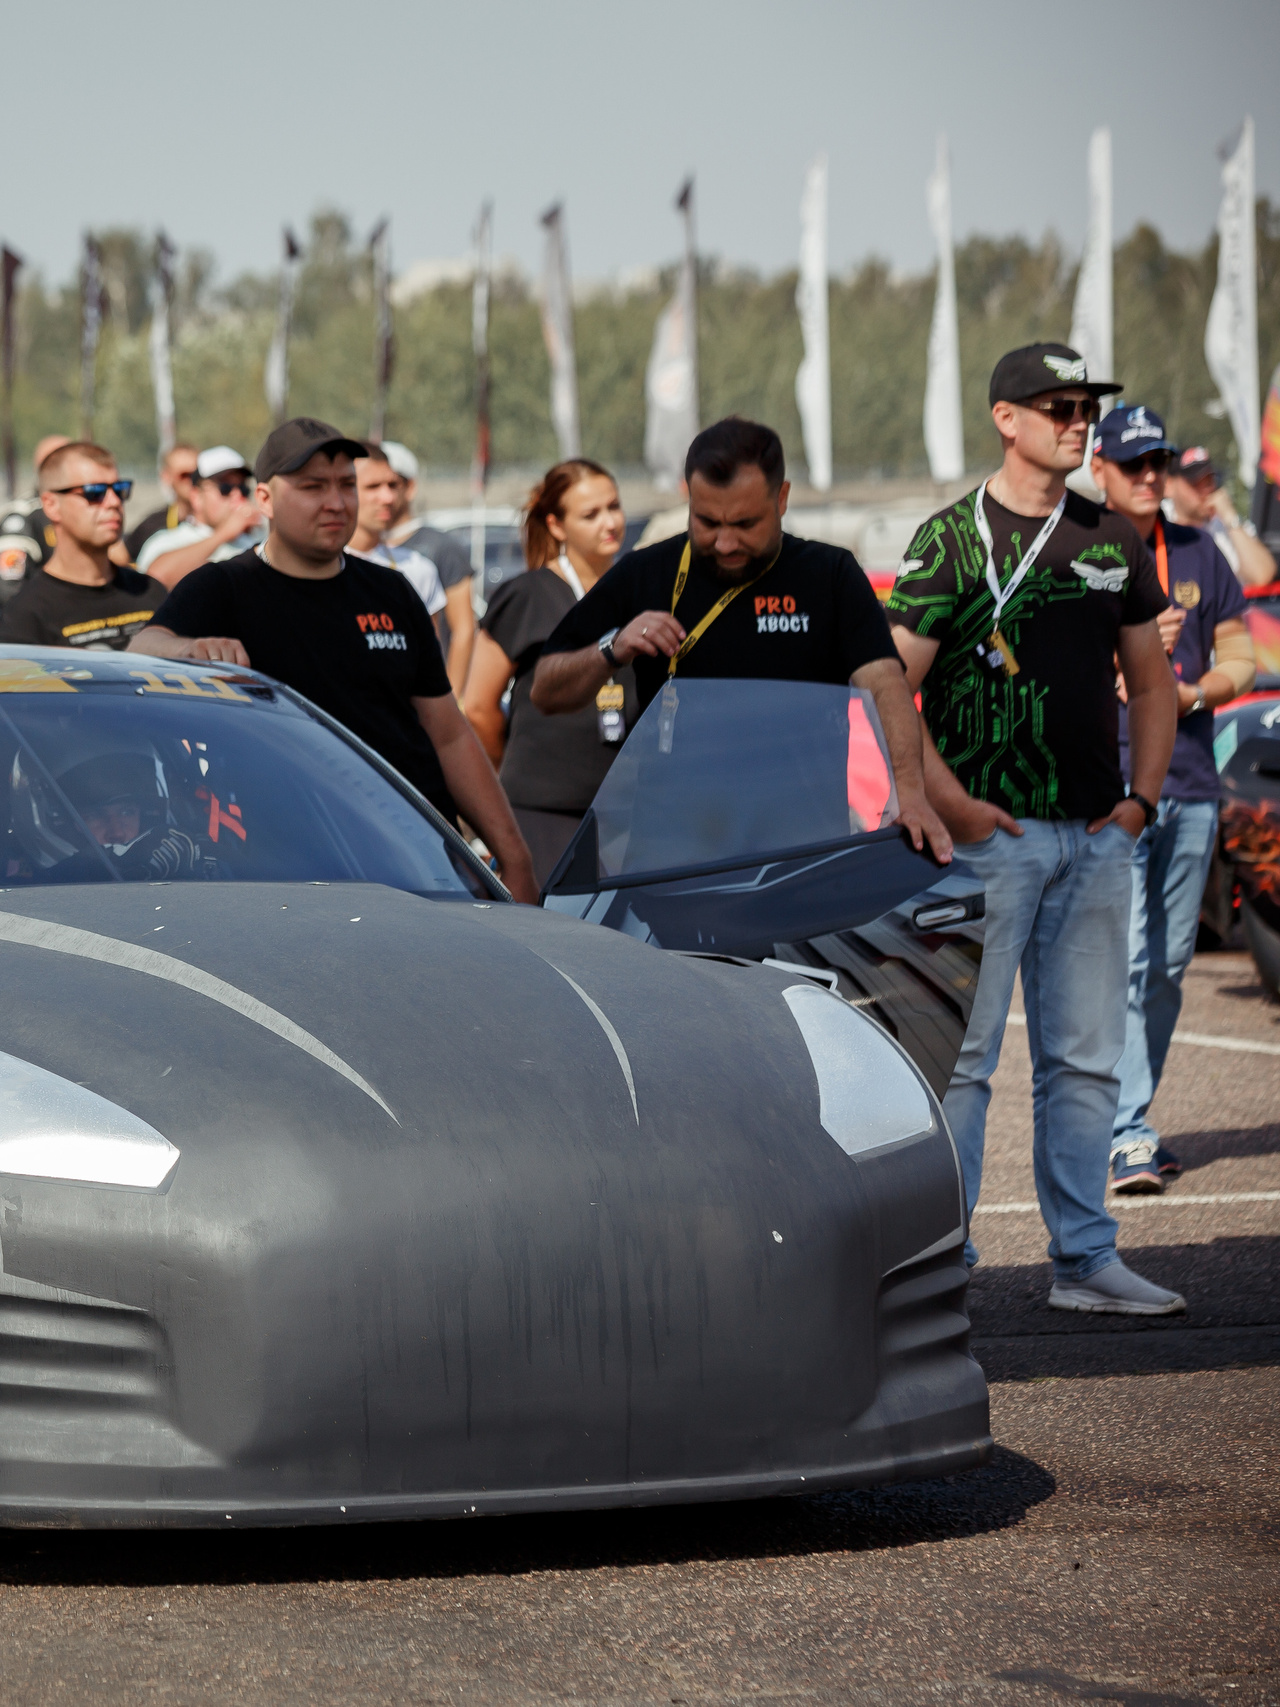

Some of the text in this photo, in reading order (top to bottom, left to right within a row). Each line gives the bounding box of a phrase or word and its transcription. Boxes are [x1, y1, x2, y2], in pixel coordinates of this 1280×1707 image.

[754, 595, 796, 615] PRO
[356, 613, 394, 632] PRO
[757, 613, 810, 633] ХВОСТ
[129, 670, 253, 703] 111
